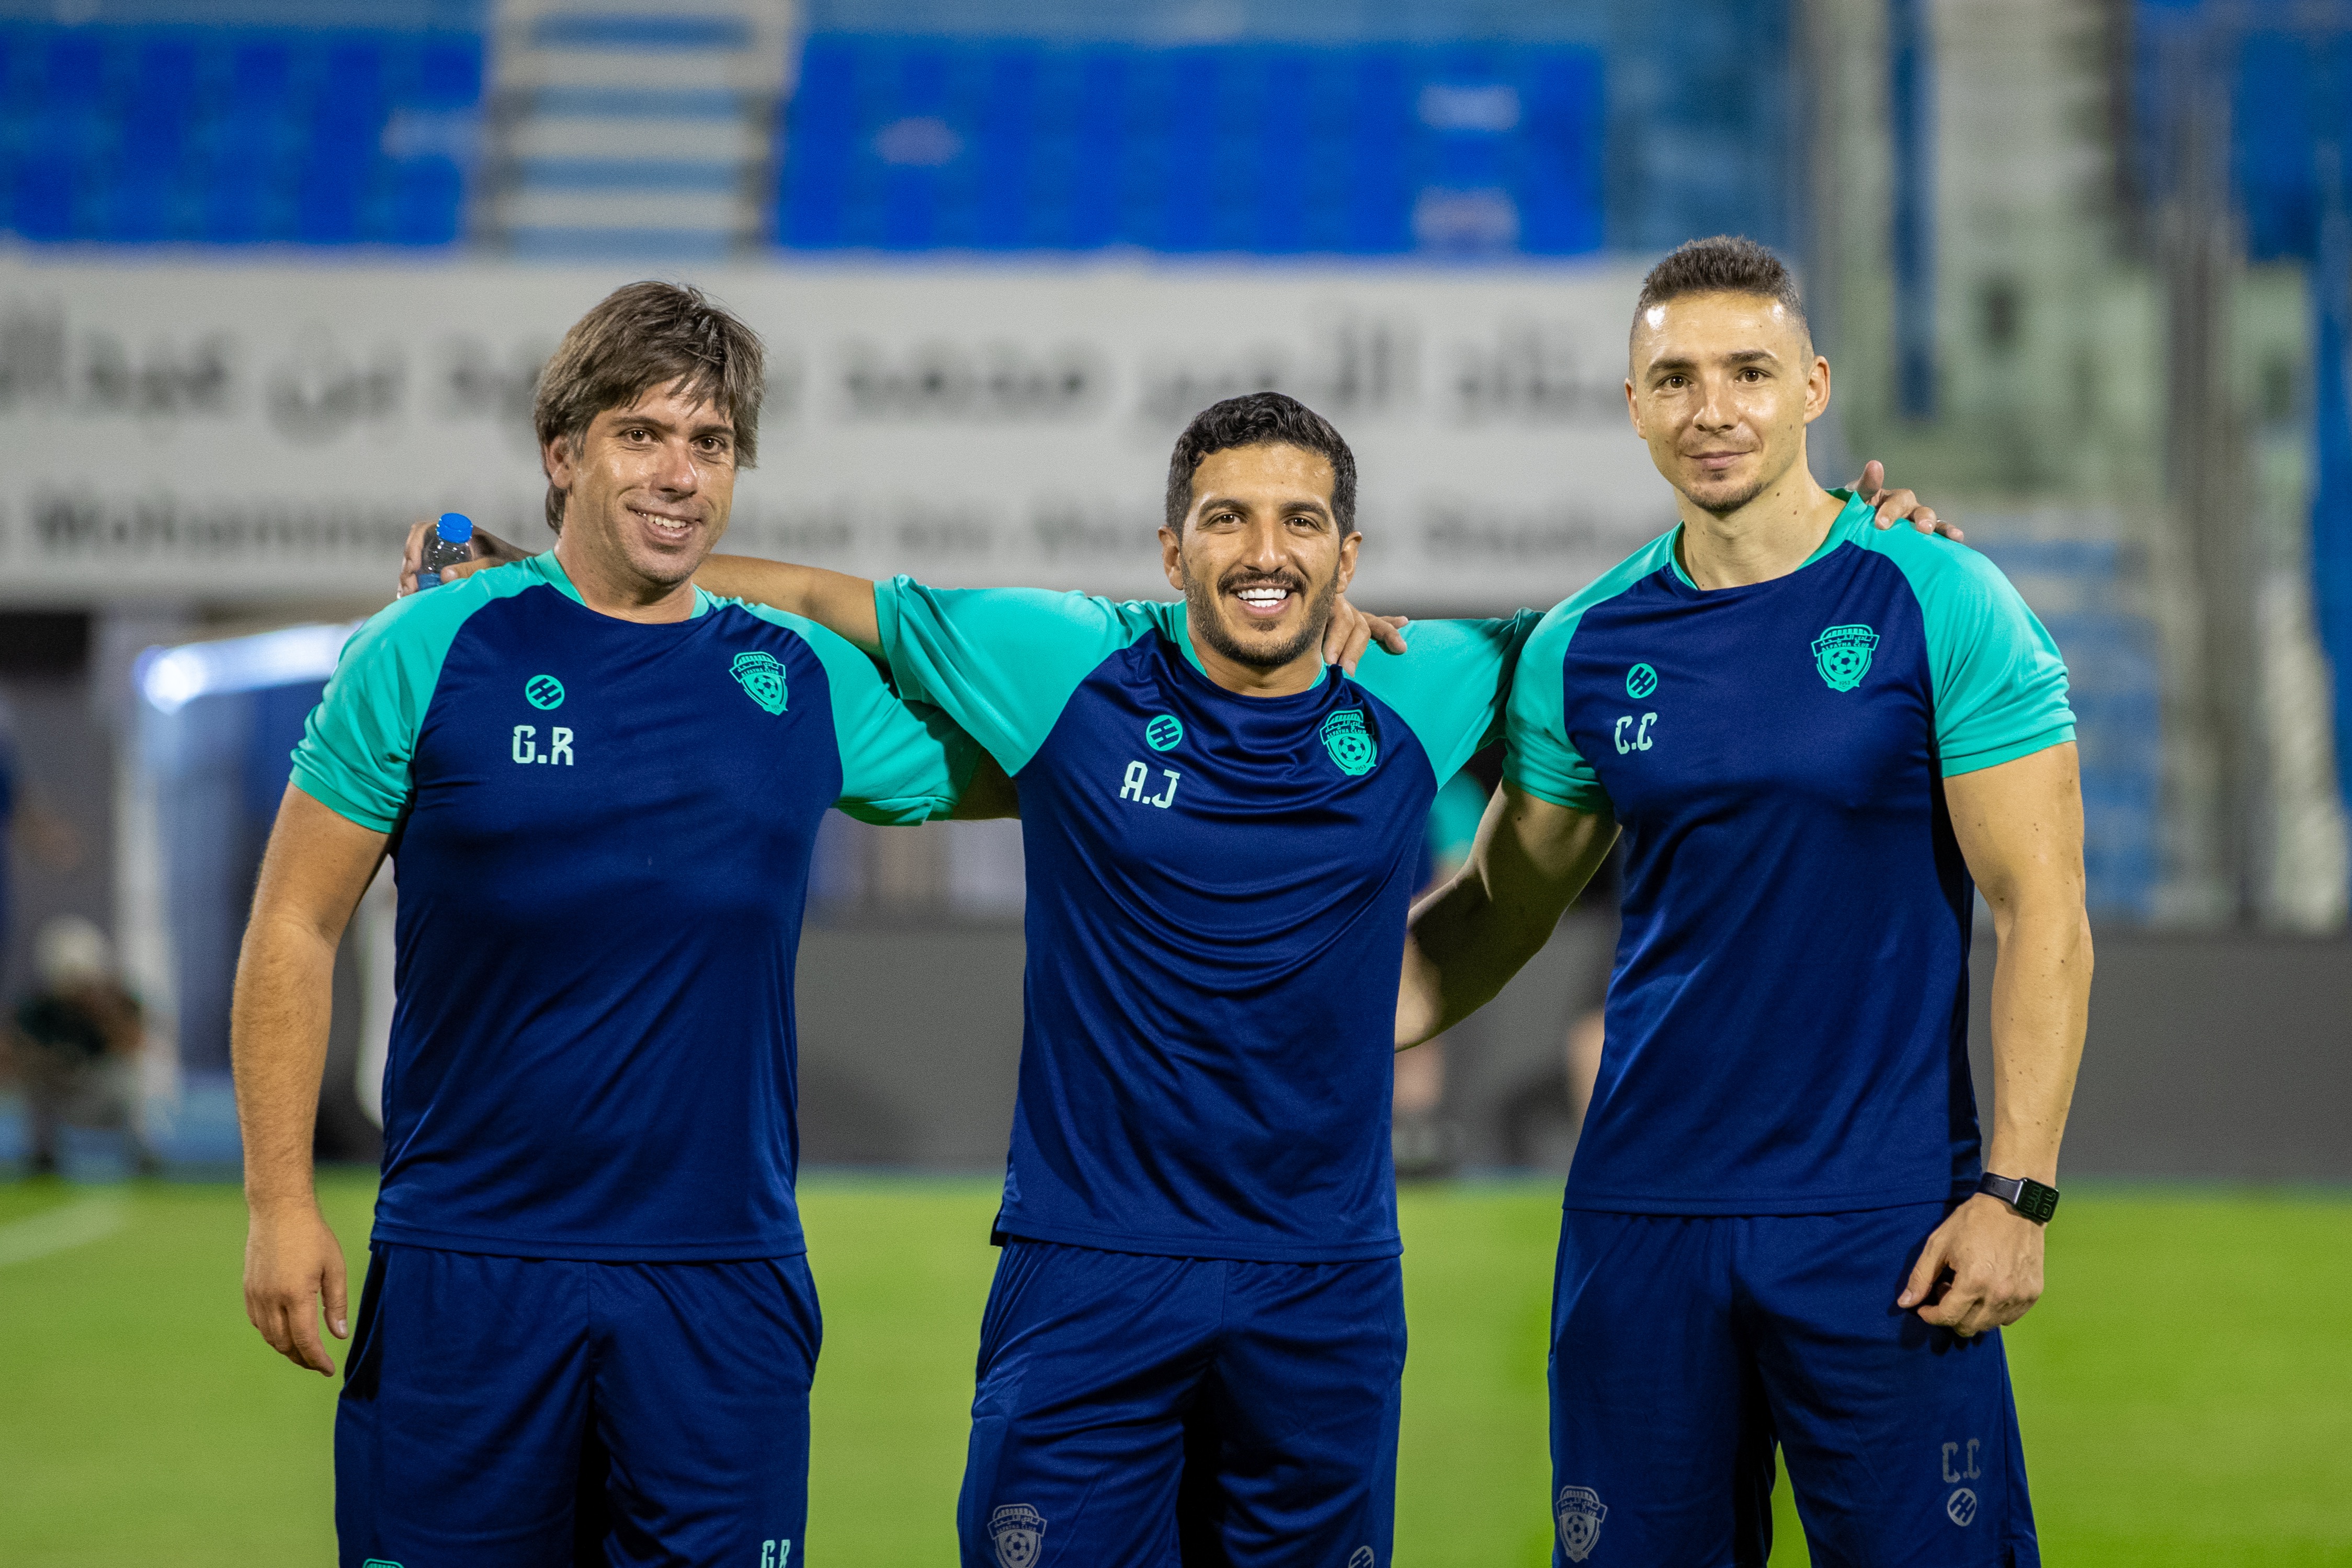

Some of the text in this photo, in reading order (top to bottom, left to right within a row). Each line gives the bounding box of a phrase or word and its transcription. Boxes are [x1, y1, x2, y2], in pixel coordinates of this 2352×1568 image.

[1822, 642, 1851, 652] ALFAYHA
[513, 725, 574, 766] G.R
[1326, 729, 1349, 740] ALFAYHA
[1615, 712, 1657, 754] C.C
[1119, 760, 1180, 809] A.J
[1942, 1438, 1981, 1483] C.C
